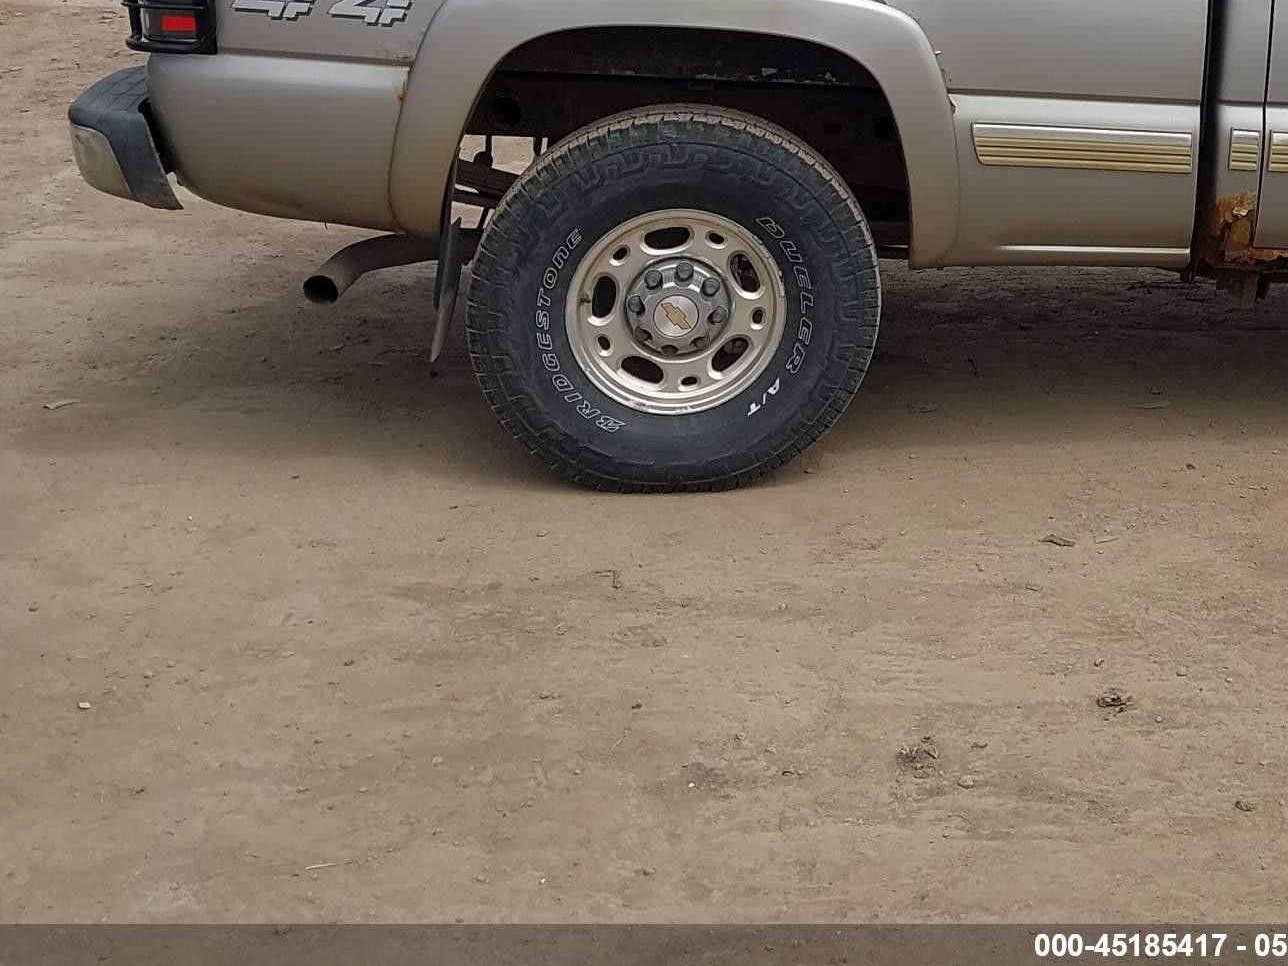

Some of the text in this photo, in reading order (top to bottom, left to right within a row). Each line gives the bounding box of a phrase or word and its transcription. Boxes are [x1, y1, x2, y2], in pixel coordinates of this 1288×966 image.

[535, 227, 627, 433] BRIDGESTONE
[747, 216, 814, 418] DUELER A/T
